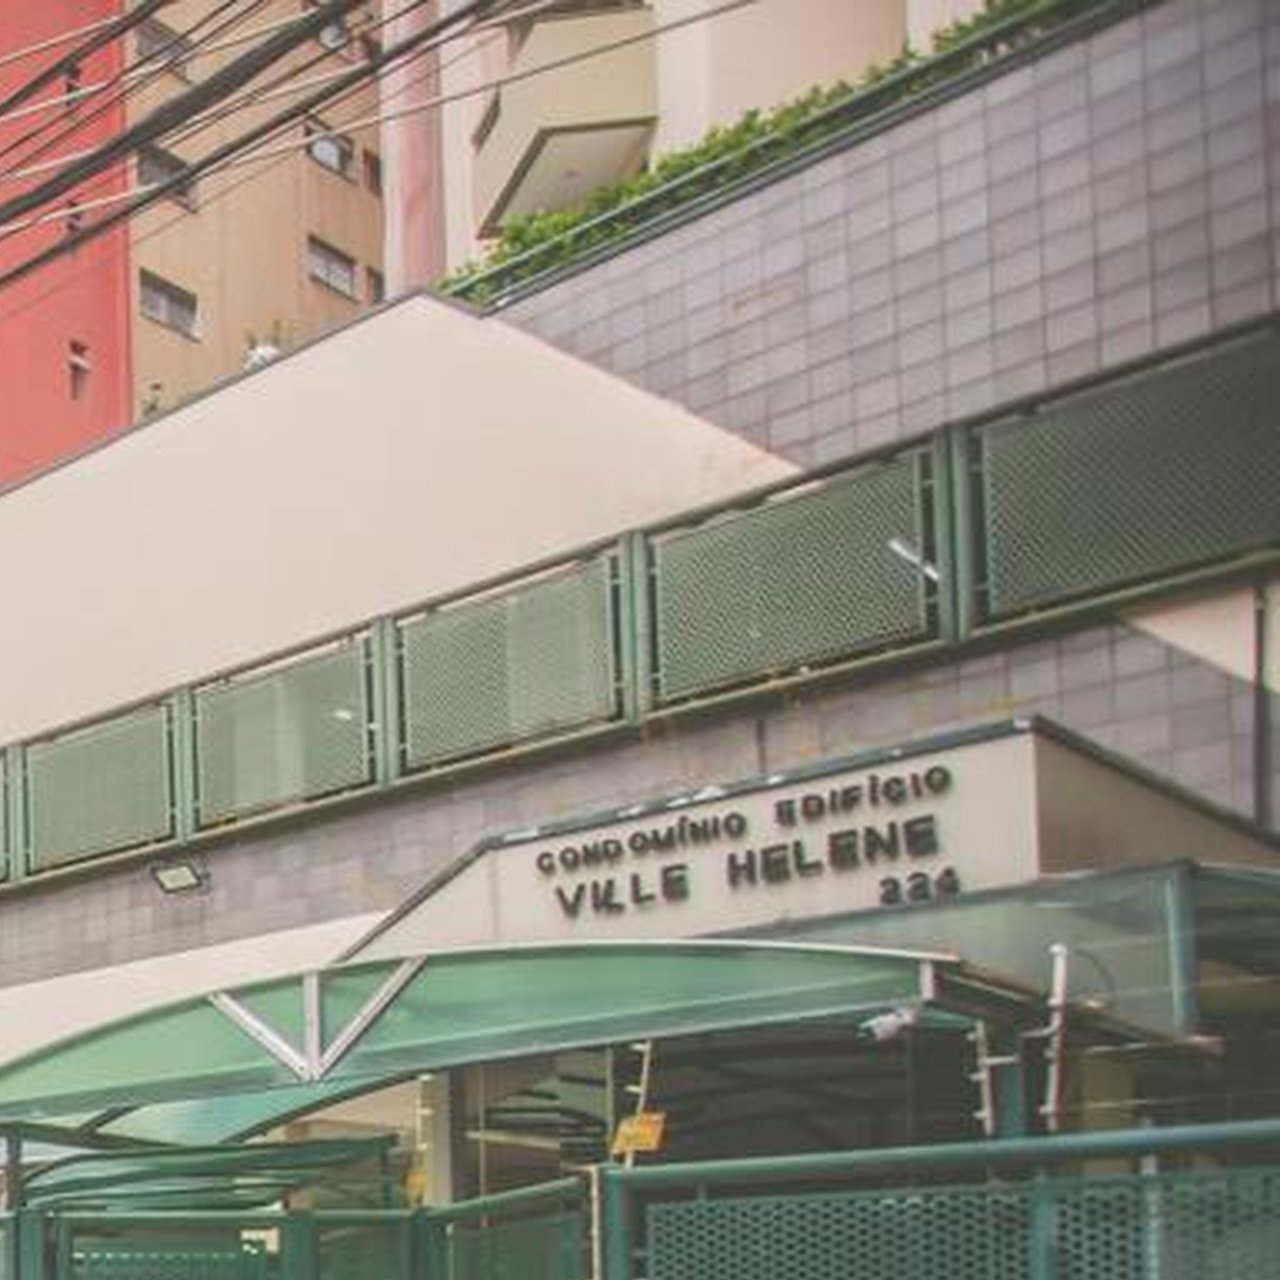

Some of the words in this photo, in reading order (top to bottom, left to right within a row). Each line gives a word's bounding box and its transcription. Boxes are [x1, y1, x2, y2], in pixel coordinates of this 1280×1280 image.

[536, 814, 748, 876] CONDOMÍNIO
[774, 766, 951, 828] EDIFÍCIO
[556, 863, 690, 918] VILLE
[727, 814, 939, 888] HELENE
